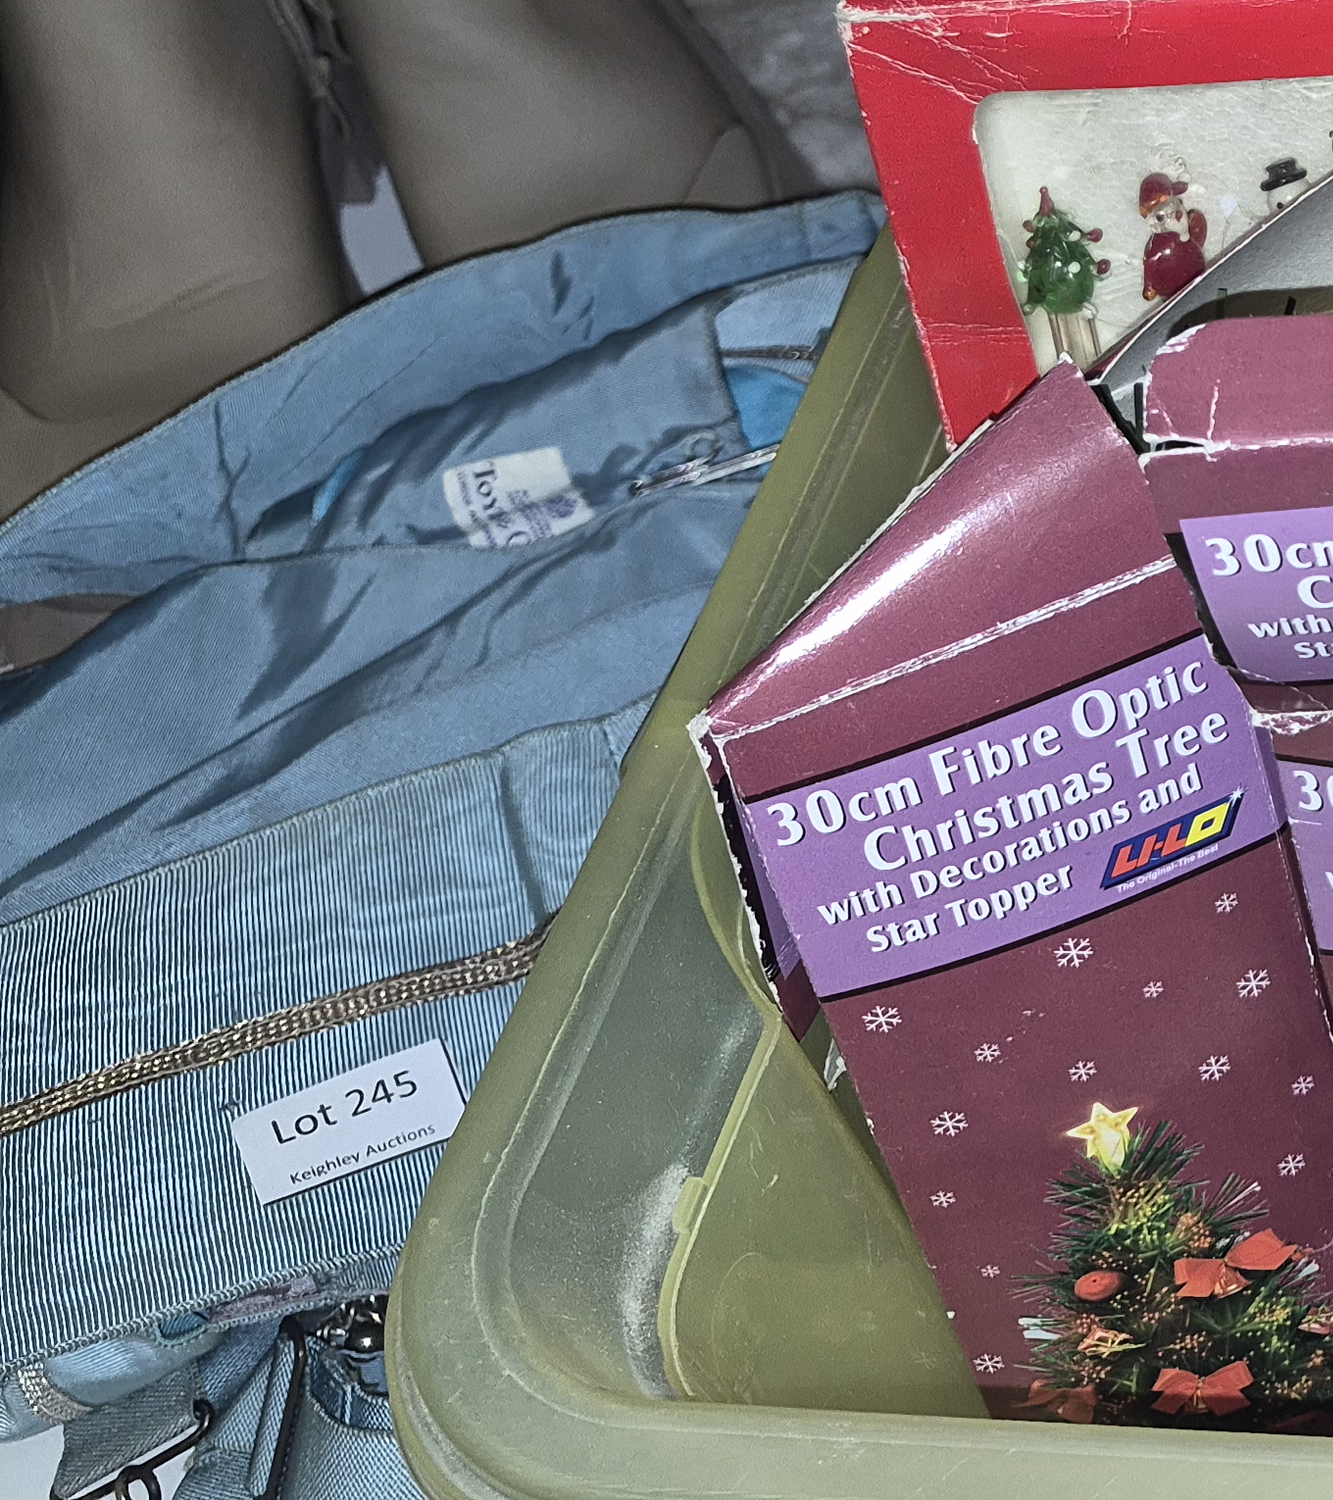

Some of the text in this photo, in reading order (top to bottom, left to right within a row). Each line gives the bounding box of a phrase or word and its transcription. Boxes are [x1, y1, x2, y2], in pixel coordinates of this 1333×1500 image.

[1248, 614, 1331, 639] with
[767, 661, 1208, 847] 30cm Fibre Optic
[863, 711, 1228, 871] Christmas Tree
[817, 763, 1202, 925] with Decorations and
[1116, 881, 1135, 892] The
[1197, 844, 1218, 858] Best
[866, 864, 1073, 952] Star Topper
[271, 1070, 417, 1144] Lot 245
[289, 1124, 436, 1185] Keighley Auctions
